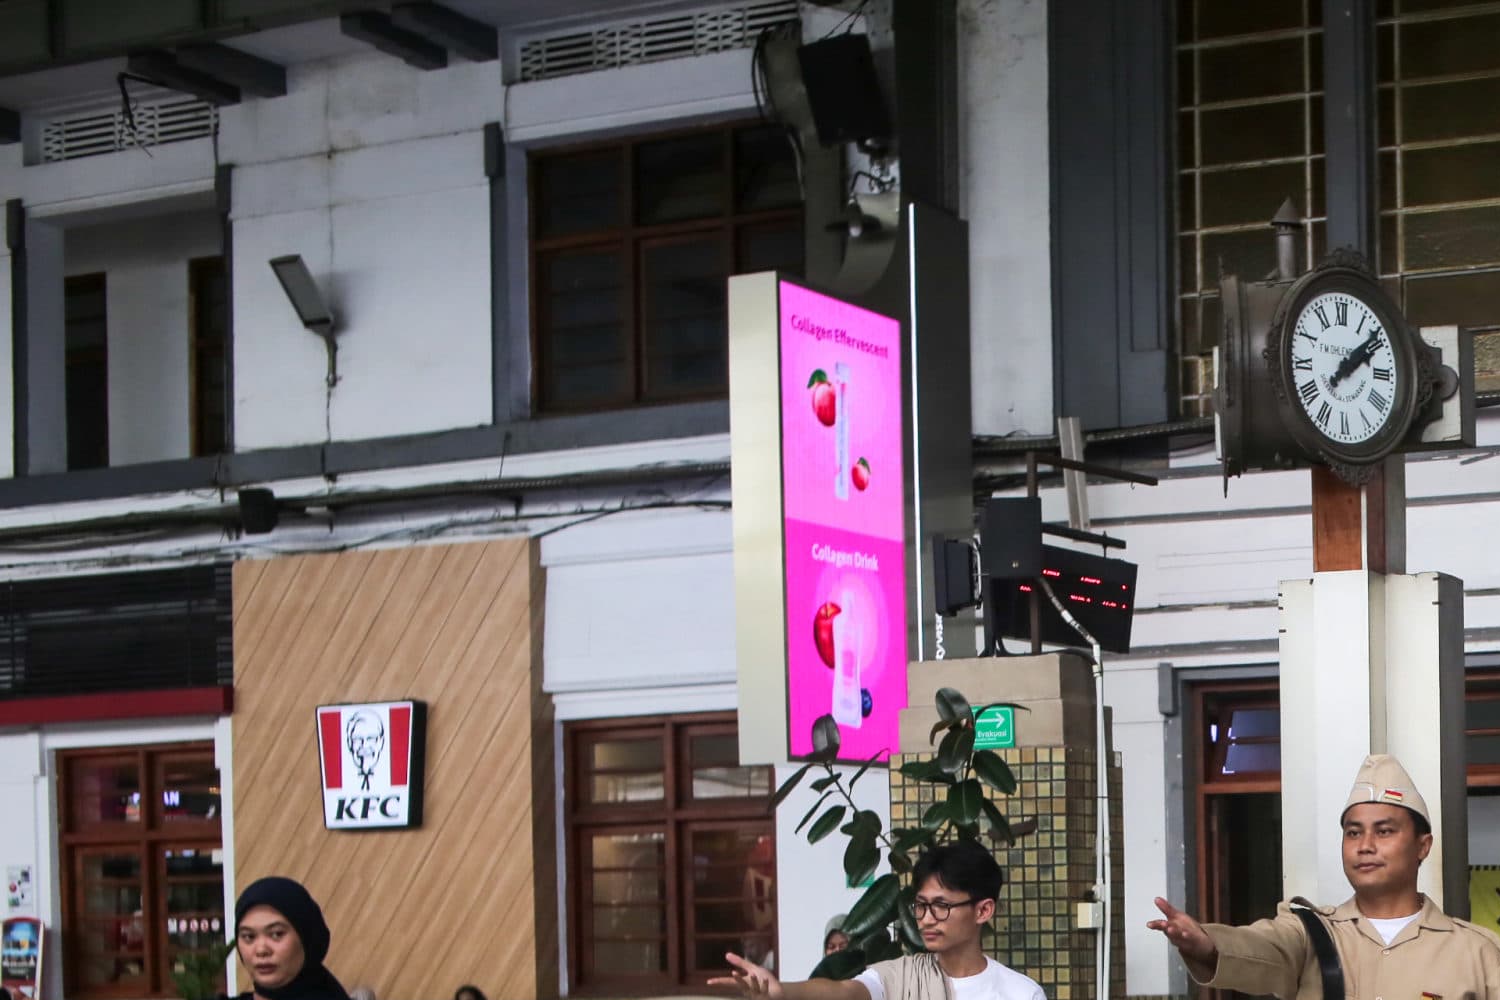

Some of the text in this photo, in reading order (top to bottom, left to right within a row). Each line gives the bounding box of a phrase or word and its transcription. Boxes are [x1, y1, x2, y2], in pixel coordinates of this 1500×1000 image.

[791, 314, 889, 359] Collagen Effervescent
[811, 543, 879, 571] Collagen Drink
[335, 795, 400, 820] KFC
